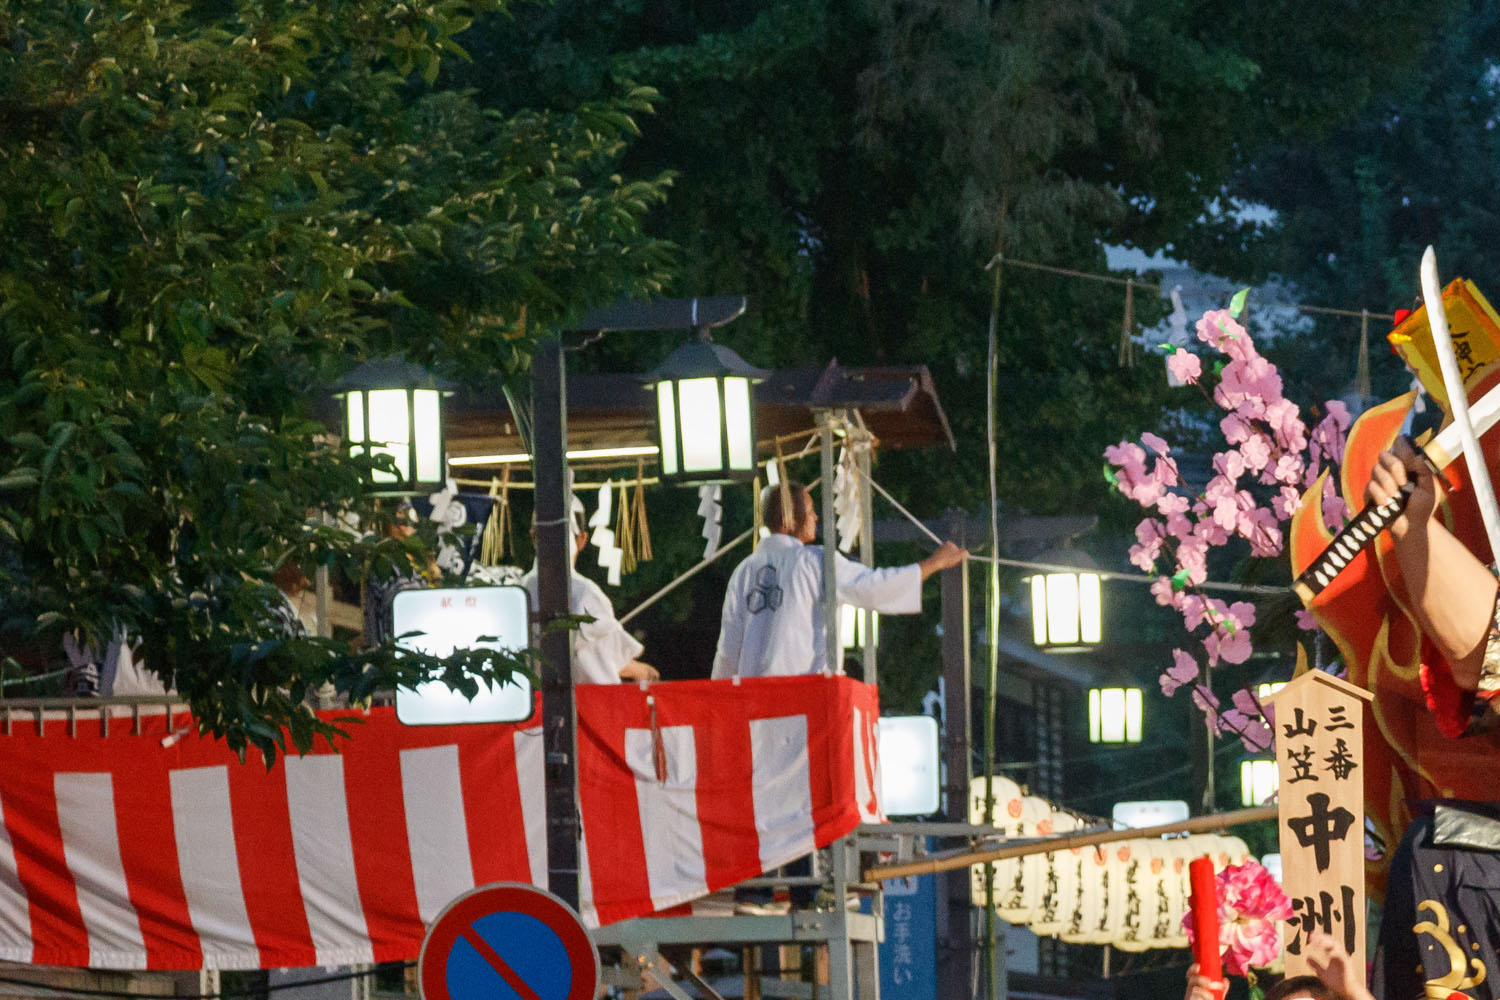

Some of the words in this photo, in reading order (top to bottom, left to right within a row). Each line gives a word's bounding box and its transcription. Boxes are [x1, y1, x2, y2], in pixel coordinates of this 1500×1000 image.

[1283, 708, 1319, 783] 山笠
[1324, 706, 1358, 781] 三番
[1287, 792, 1355, 956] 中洲
